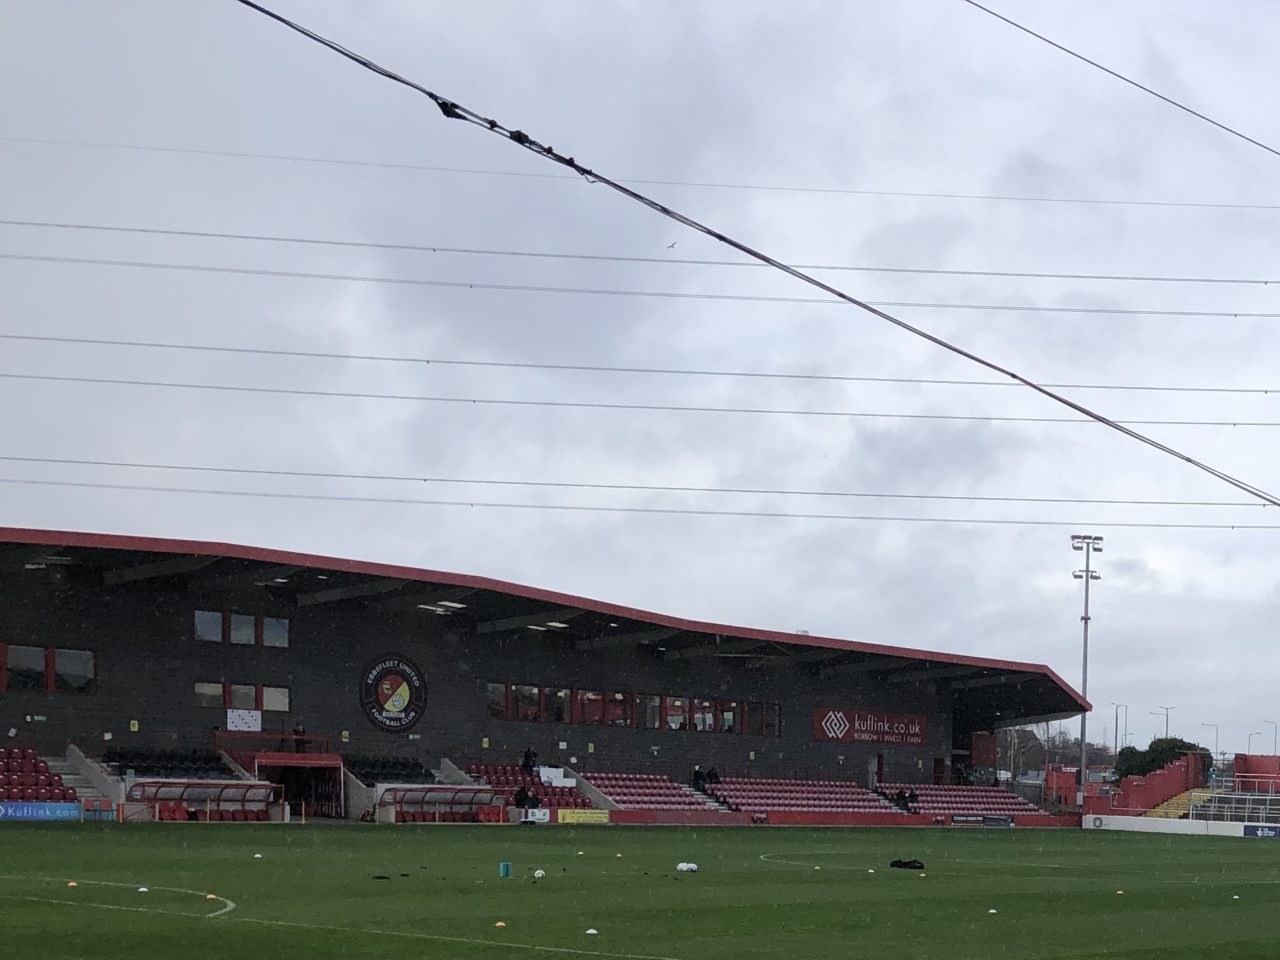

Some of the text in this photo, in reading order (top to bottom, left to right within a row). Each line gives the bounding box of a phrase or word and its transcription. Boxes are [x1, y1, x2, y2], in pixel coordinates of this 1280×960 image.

[366, 660, 420, 687] EBBSFLEET UNITED
[371, 708, 401, 727] FOOTBALL
[401, 711, 416, 725] CLUB
[854, 713, 921, 734] kuflink.co.uk
